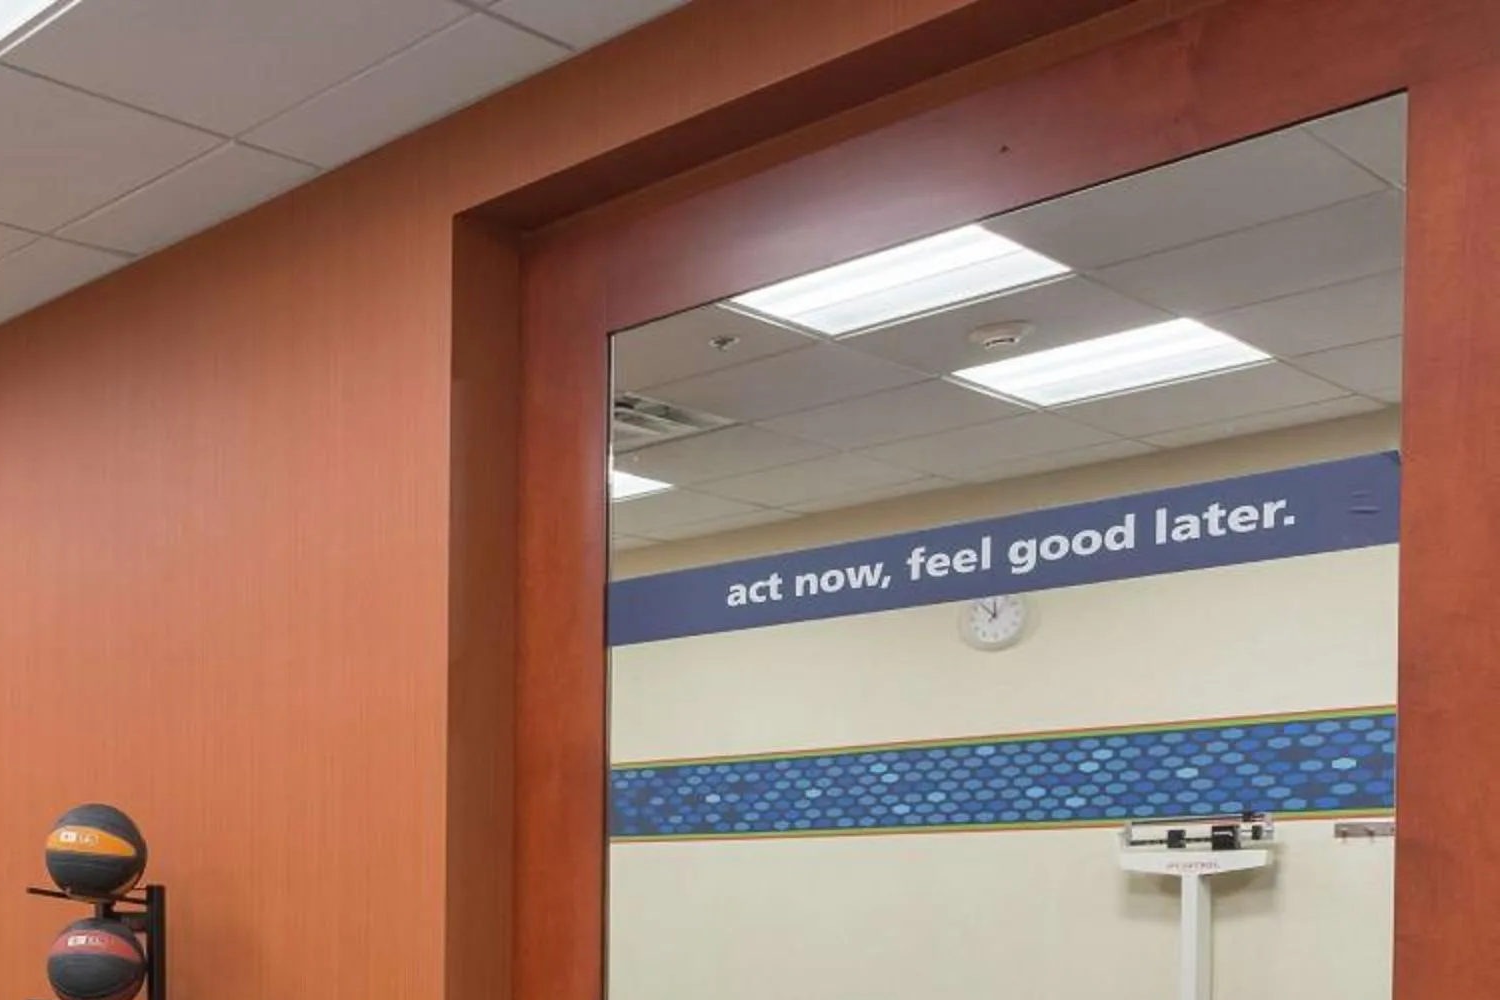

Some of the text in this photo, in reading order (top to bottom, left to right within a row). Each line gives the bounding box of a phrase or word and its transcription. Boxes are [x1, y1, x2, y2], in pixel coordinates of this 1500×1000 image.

[727, 499, 1296, 607] act now, feel good later.
